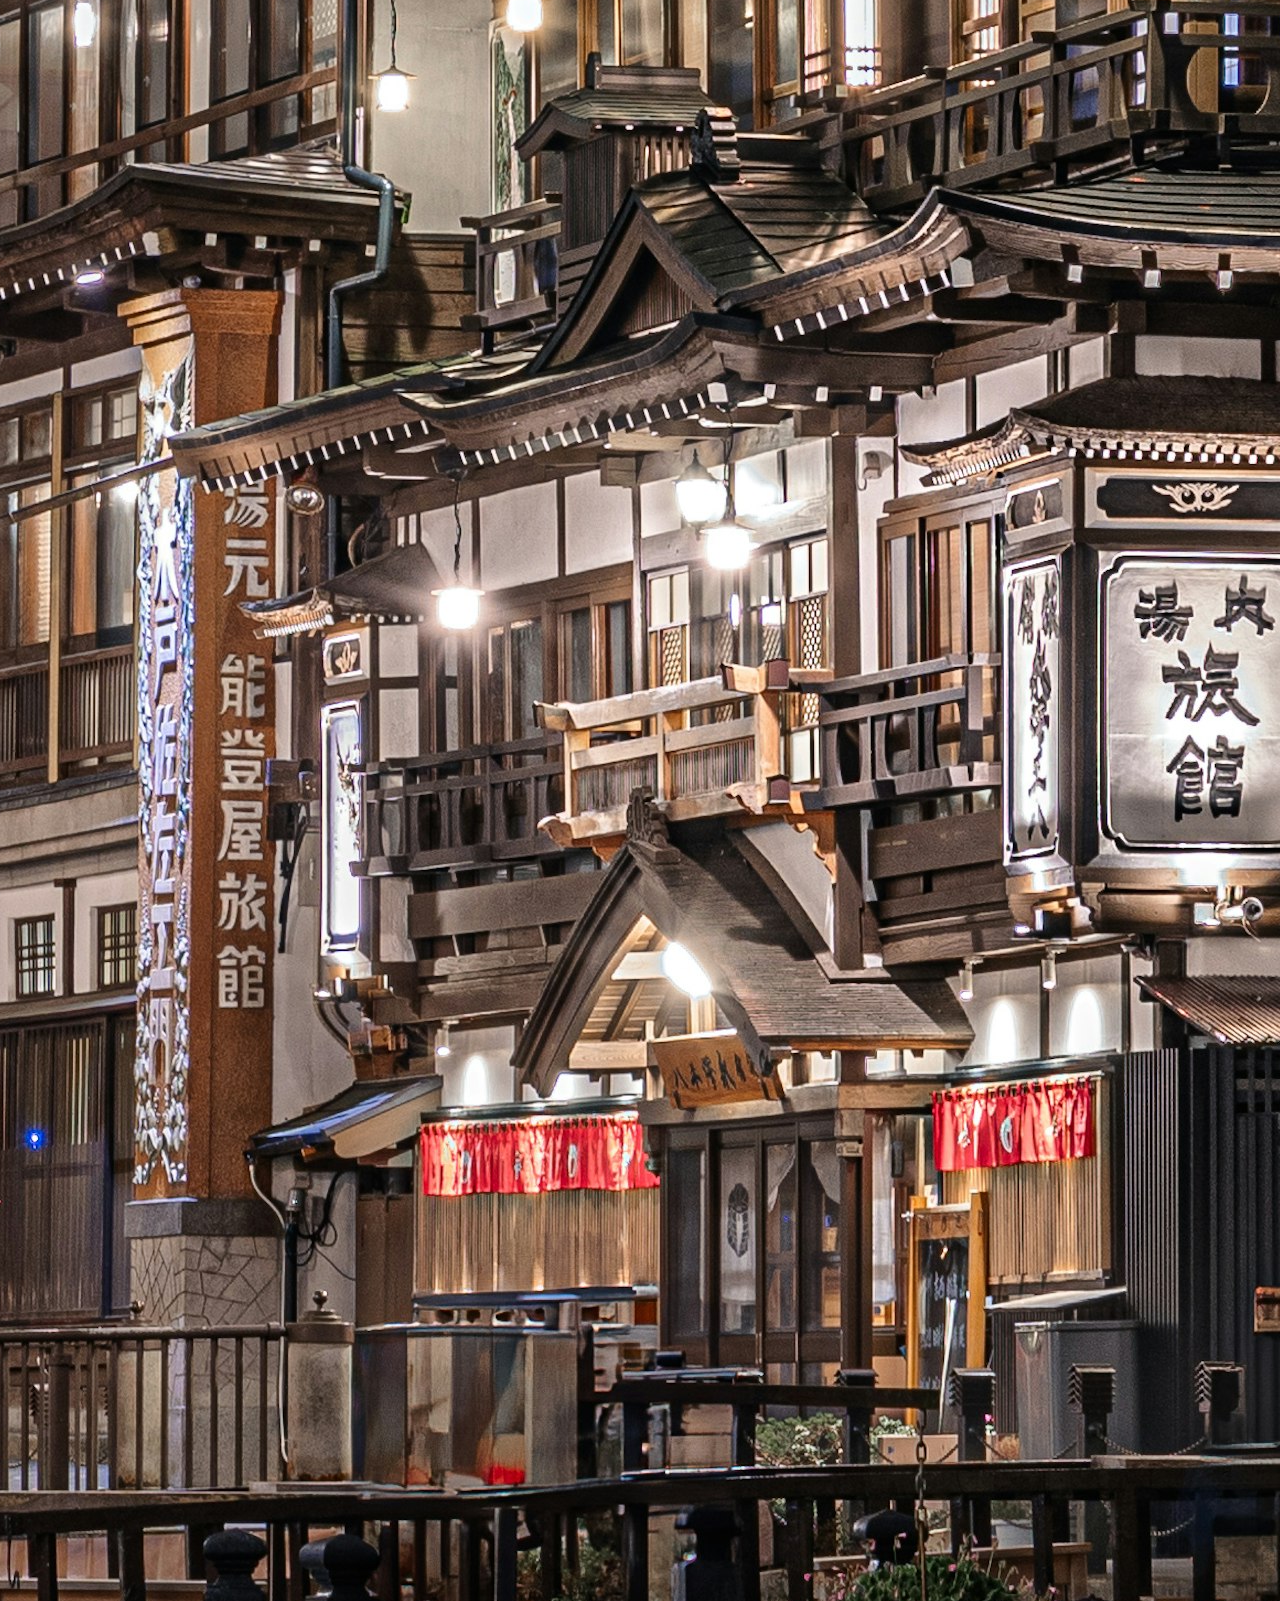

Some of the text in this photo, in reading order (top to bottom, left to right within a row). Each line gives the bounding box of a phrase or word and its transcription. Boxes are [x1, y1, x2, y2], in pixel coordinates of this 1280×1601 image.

[217, 653, 267, 1009] 能登屋旅館
